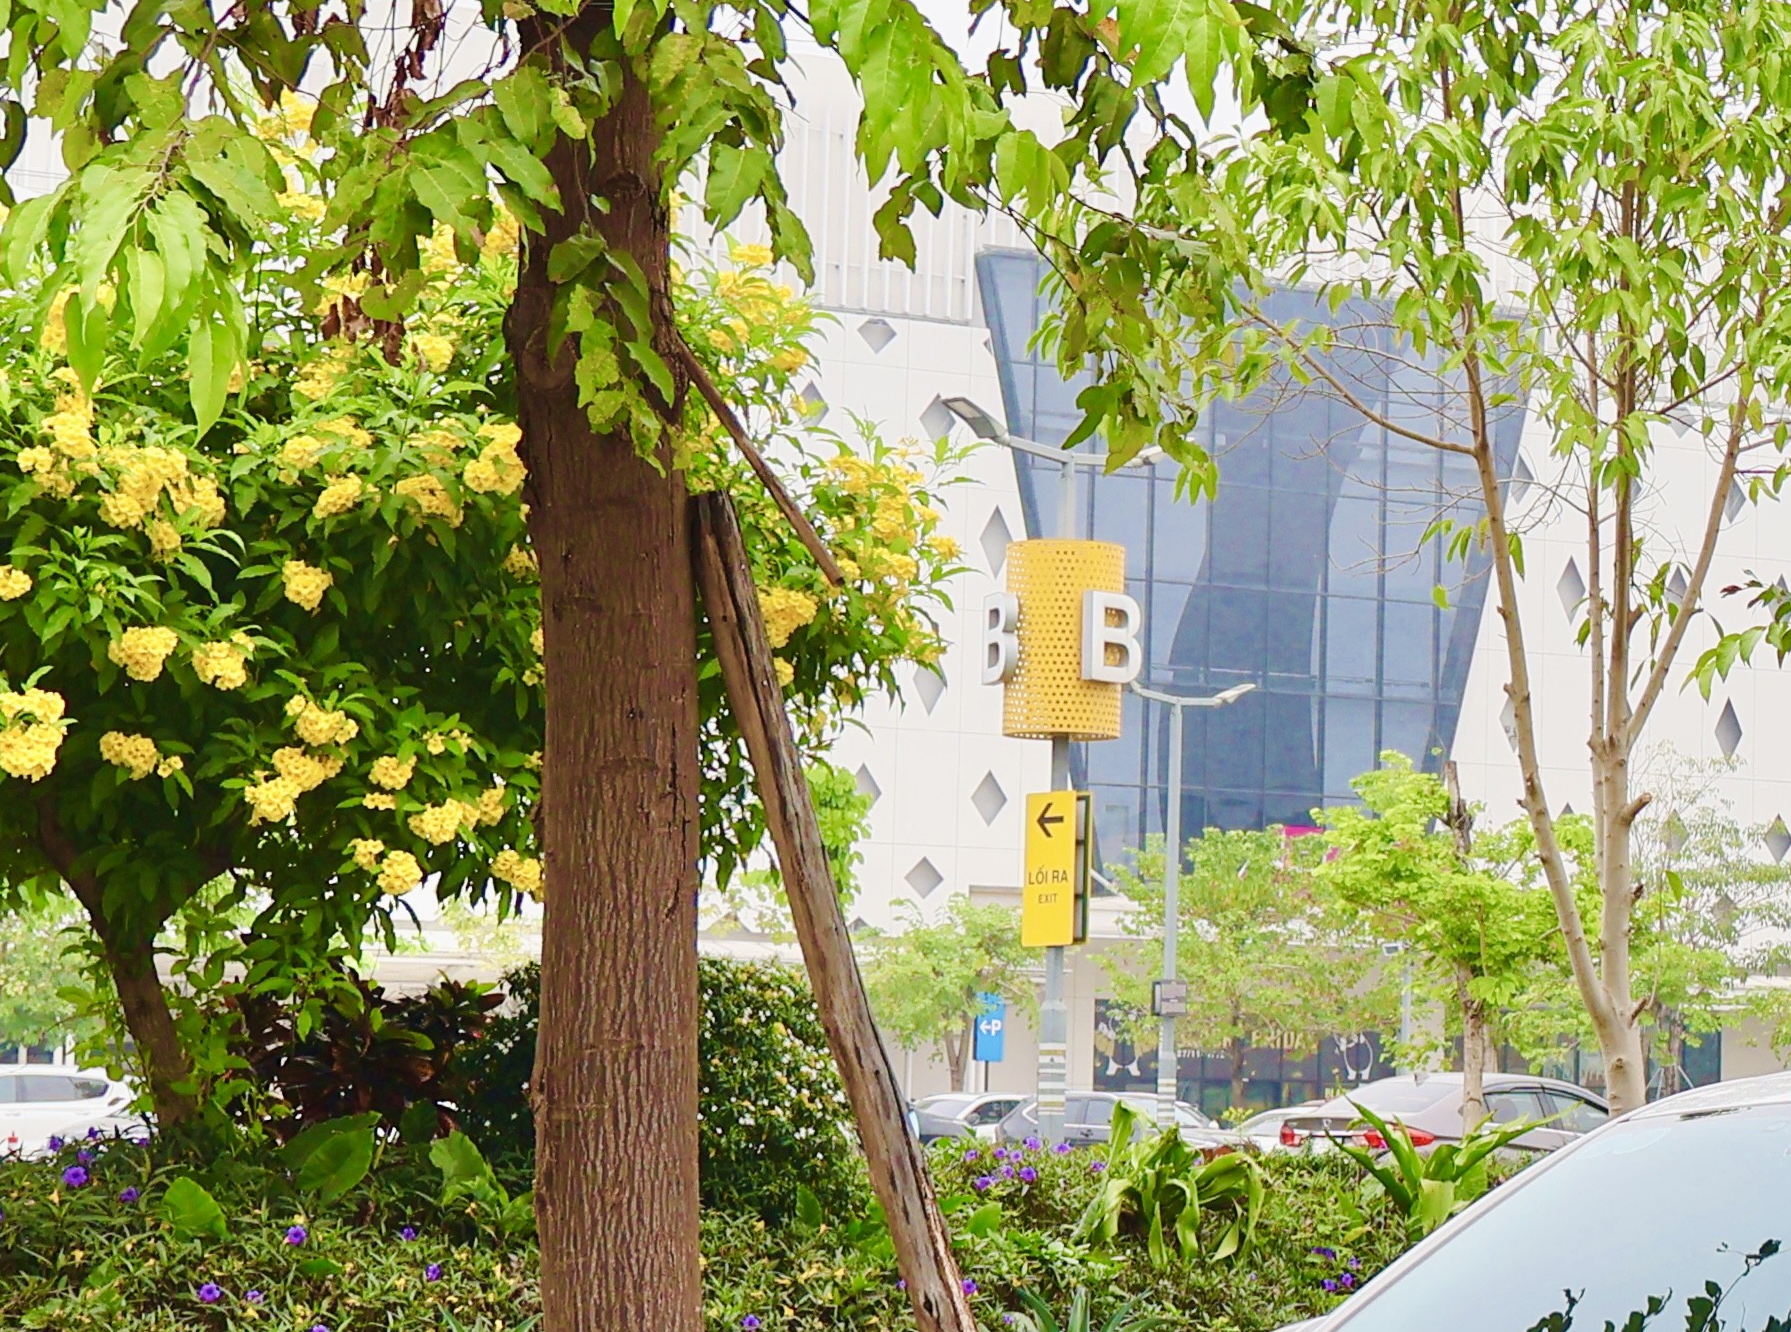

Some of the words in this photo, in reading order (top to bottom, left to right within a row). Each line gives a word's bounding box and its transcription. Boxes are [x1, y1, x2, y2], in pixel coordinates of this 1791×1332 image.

[981, 591, 1015, 686] B
[1084, 590, 1142, 684] B
[1028, 864, 1048, 885] LỐI
[1052, 869, 1068, 883] RA
[1038, 893, 1058, 904] EXIT
[991, 1018, 1001, 1036] P
